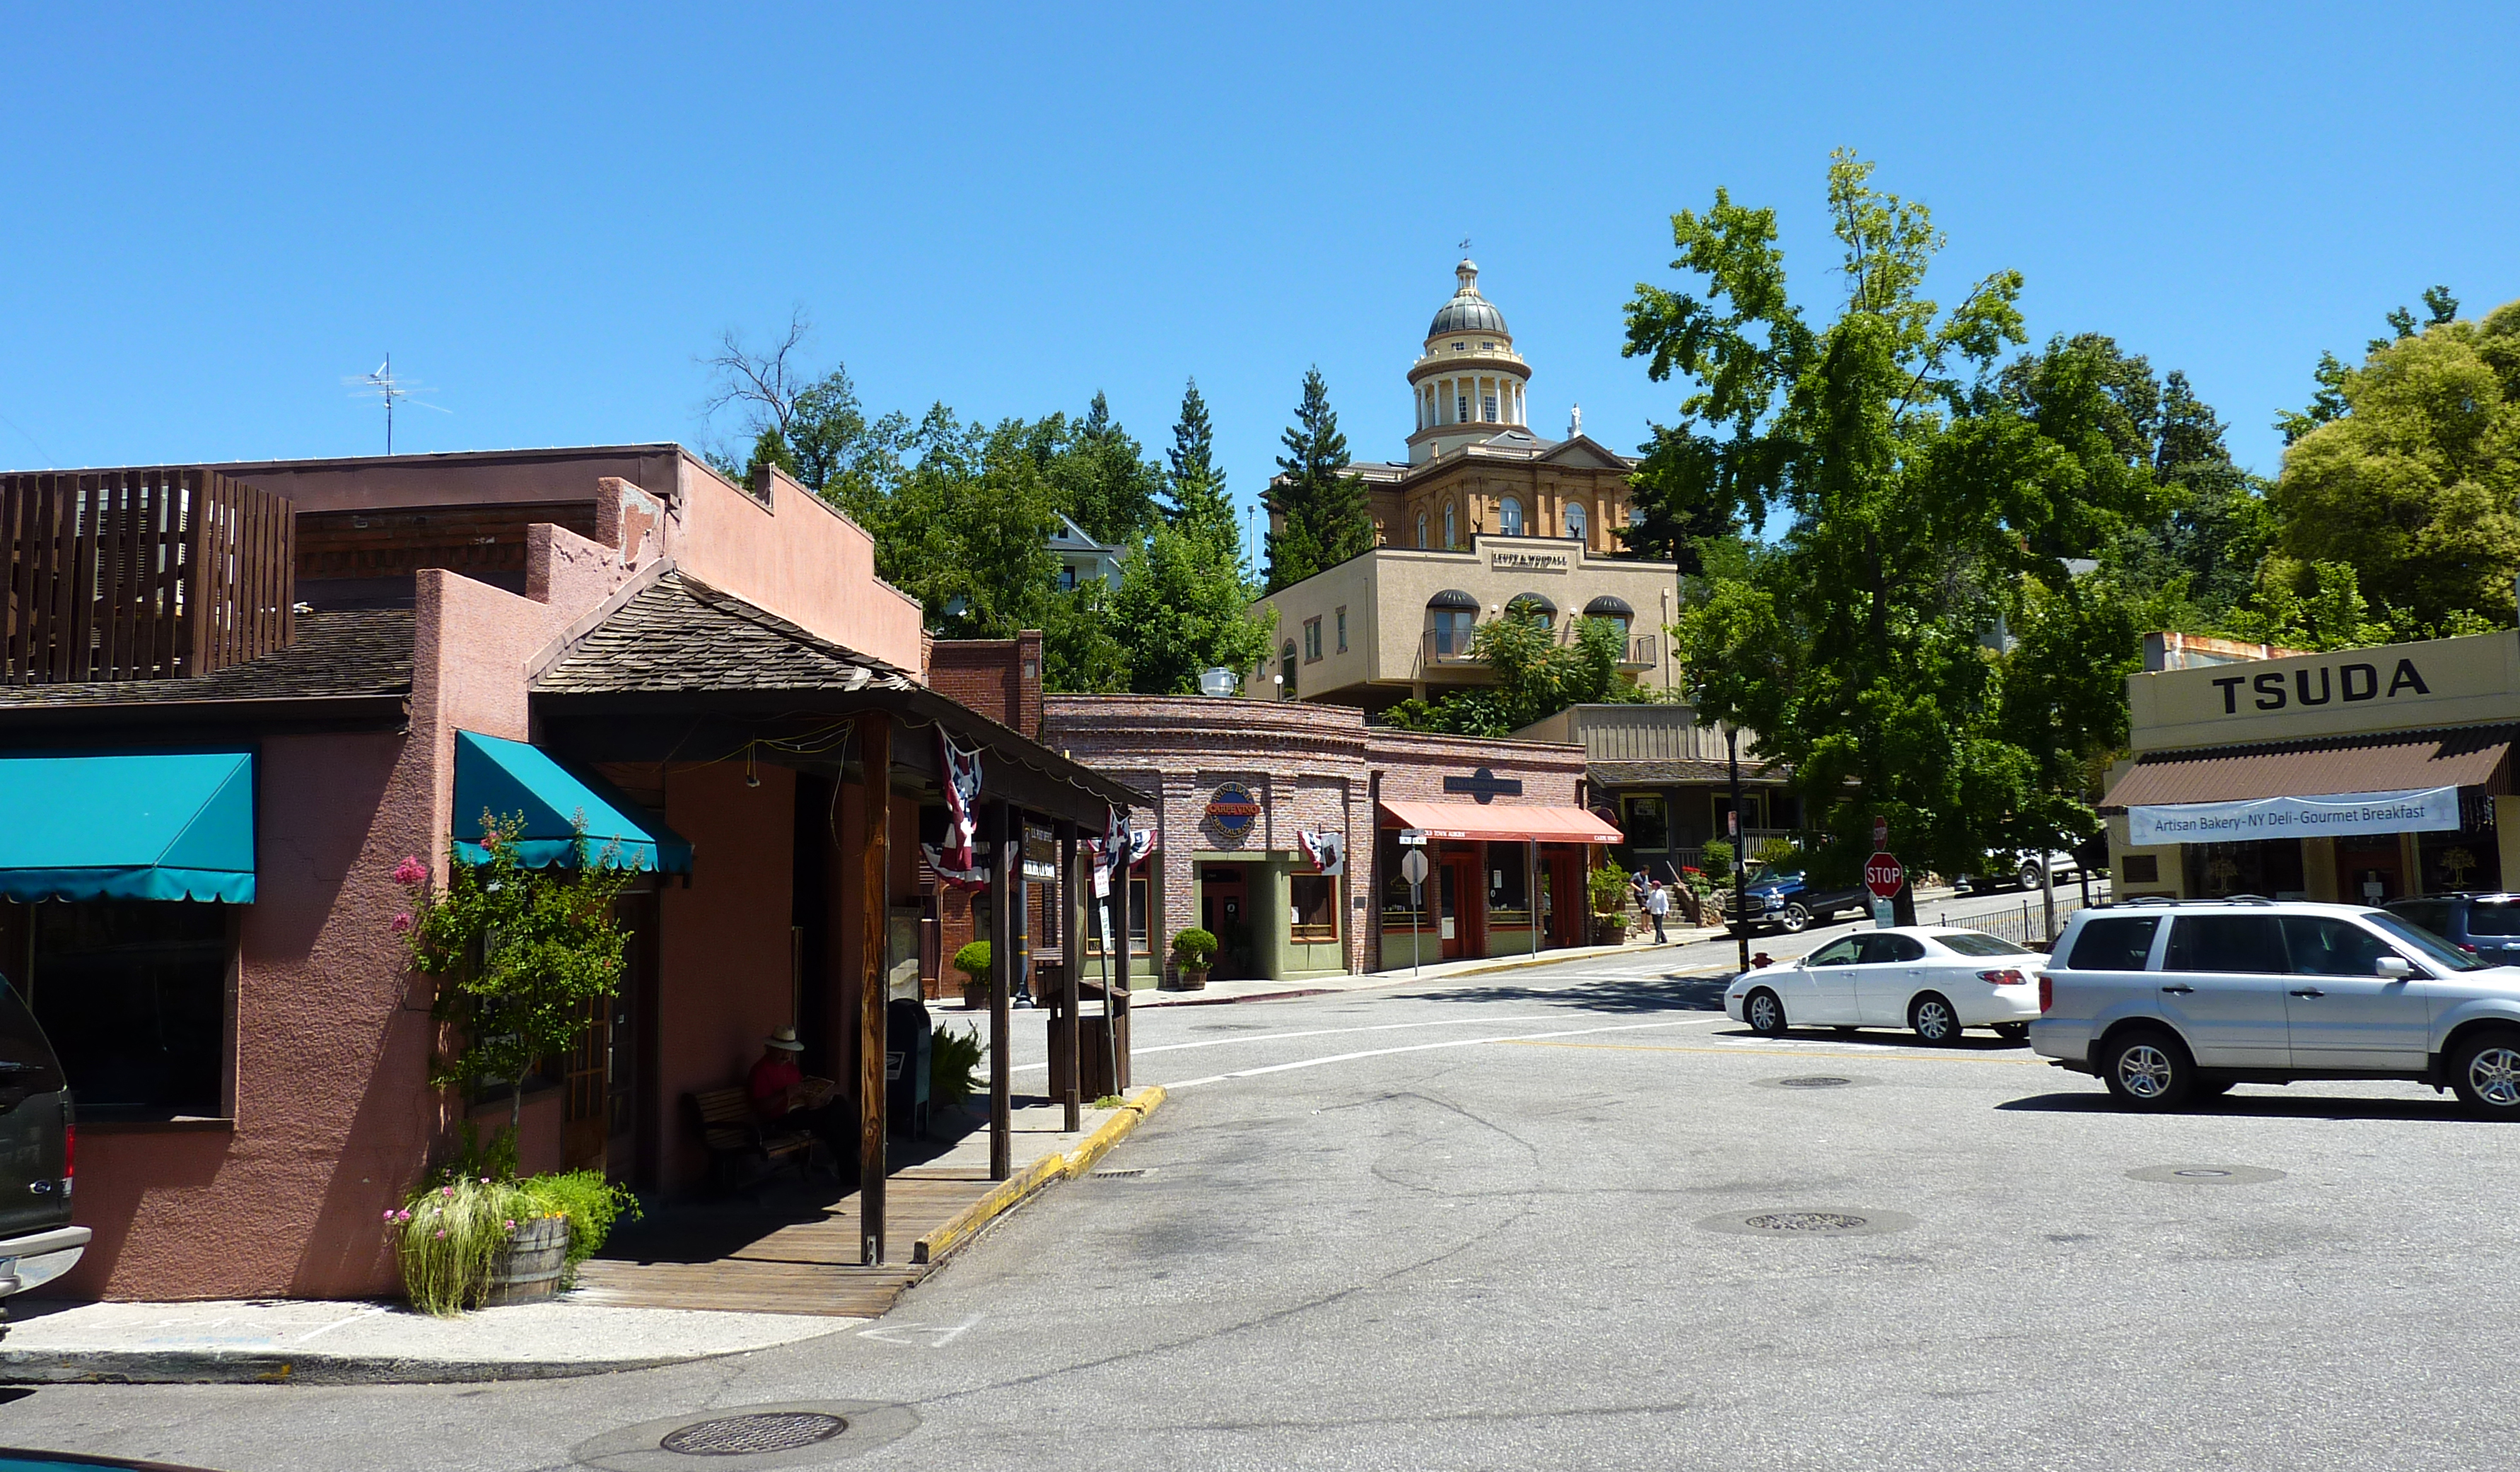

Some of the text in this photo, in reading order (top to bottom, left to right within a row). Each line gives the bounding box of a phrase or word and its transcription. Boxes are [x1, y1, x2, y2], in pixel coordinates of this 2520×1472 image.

[2212, 658, 2431, 714] TSUDA
[1213, 784, 1252, 801] WINE BAR
[1209, 805, 1257, 814] CARPE VINO
[2155, 819, 2197, 831] Artisan
[2362, 805, 2425, 822] Breakfast
[1213, 818, 1253, 835] RESTAURANT
[1874, 826, 1887, 841] STOP
[1867, 867, 1901, 884] STOP
